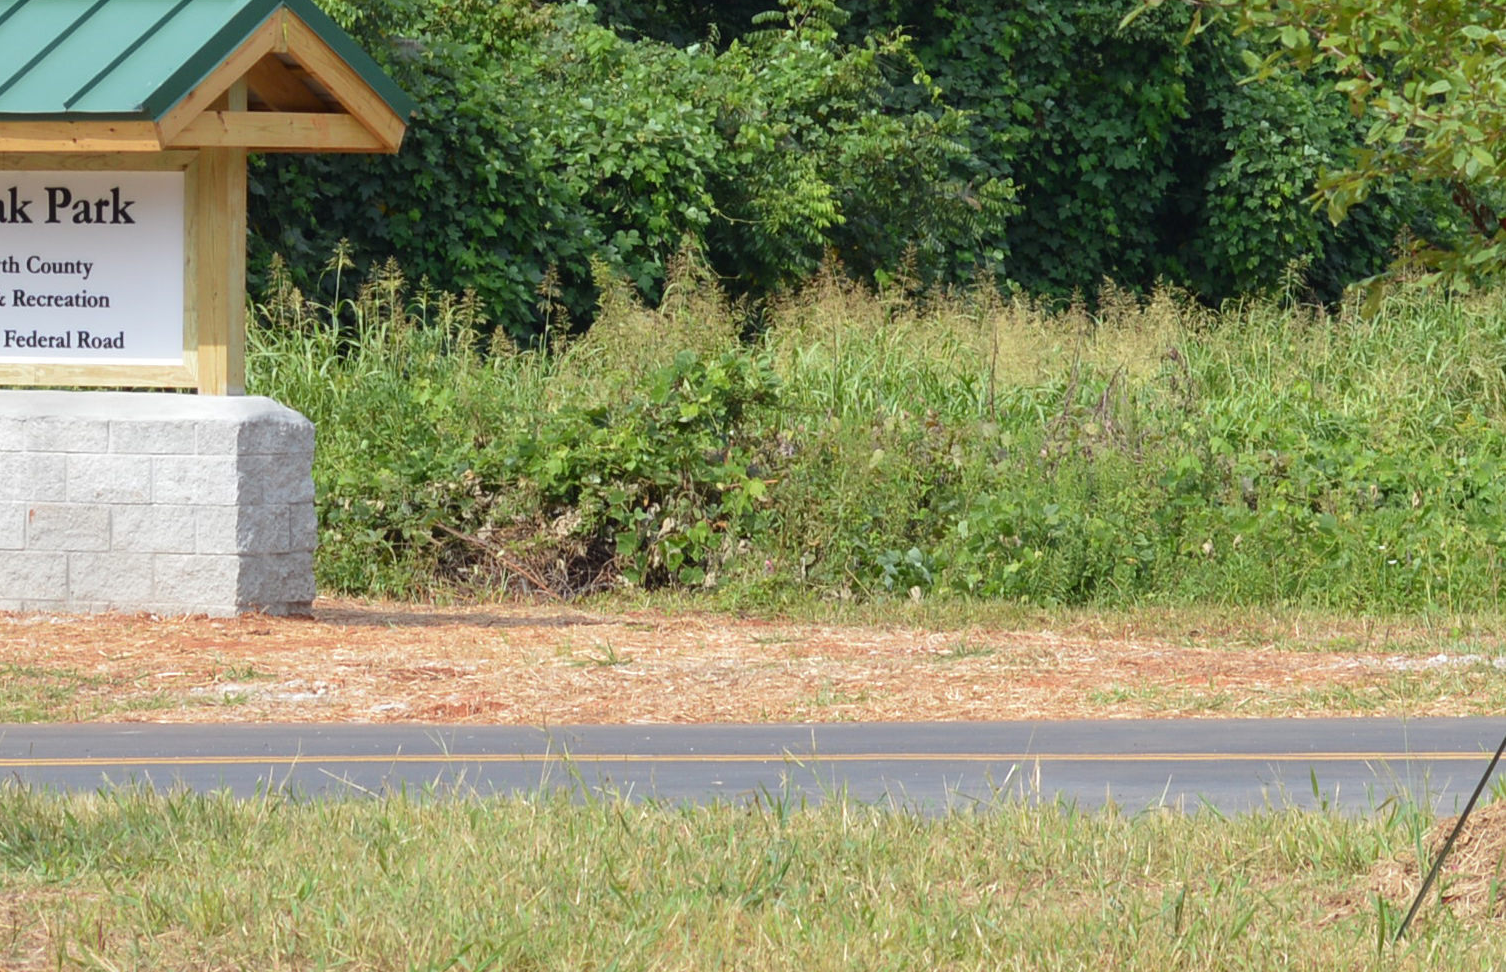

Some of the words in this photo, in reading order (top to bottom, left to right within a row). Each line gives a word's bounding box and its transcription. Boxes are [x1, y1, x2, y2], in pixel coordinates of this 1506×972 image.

[44, 186, 136, 224] Park
[26, 256, 93, 280] County
[12, 289, 110, 308] Recreation
[4, 330, 71, 348] Federal
[77, 330, 124, 349] Road
